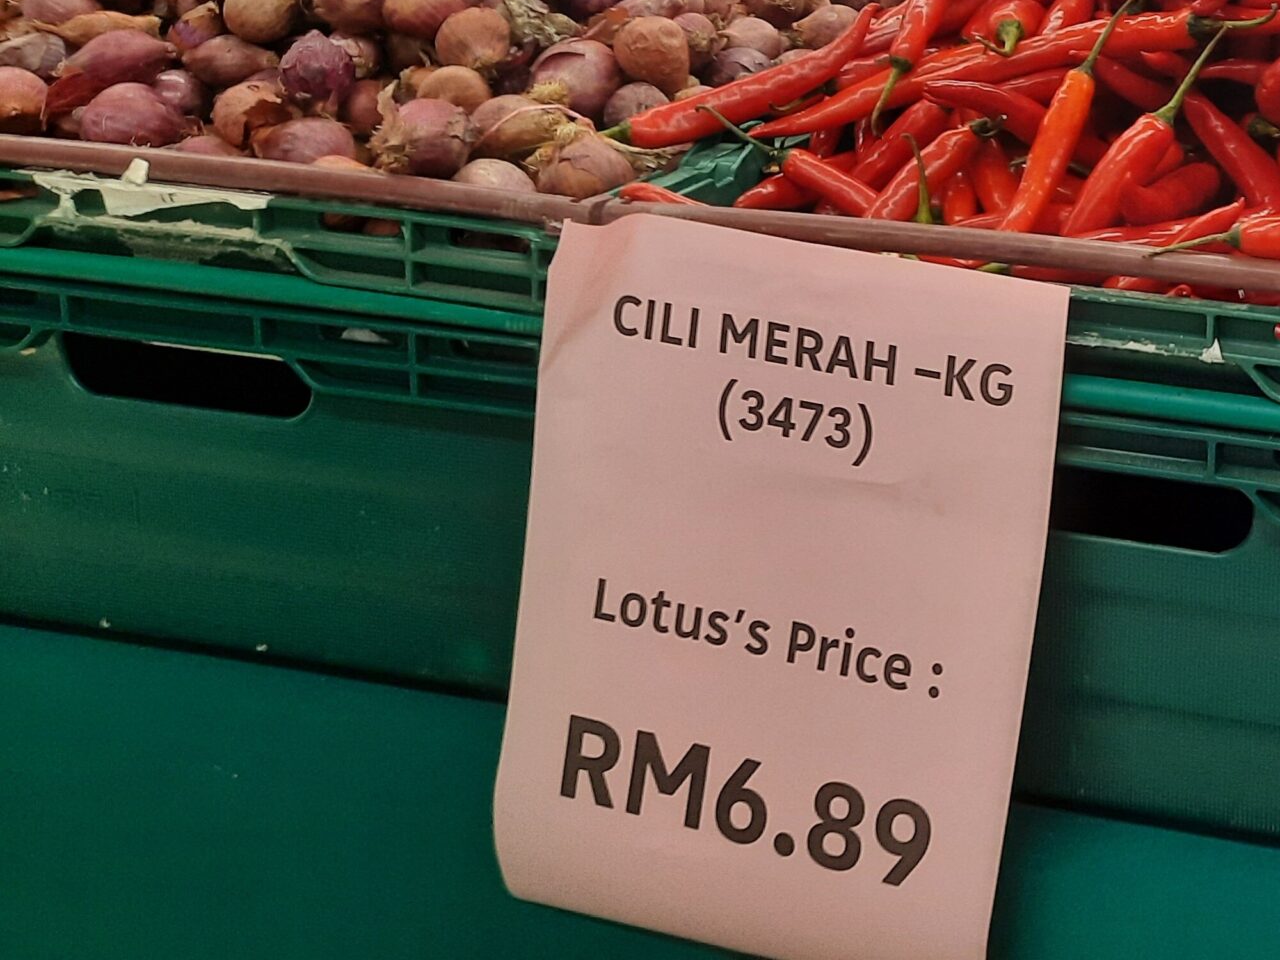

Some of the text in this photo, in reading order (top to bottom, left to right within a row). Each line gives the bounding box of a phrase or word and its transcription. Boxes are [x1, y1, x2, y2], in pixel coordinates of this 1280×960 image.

[614, 295, 700, 349] CILI
[720, 313, 897, 386] MERAH
[719, 379, 873, 466] (3473)
[594, 578, 770, 656] Lotus's
[787, 621, 911, 691] Price
[560, 715, 932, 887] RM6.89
